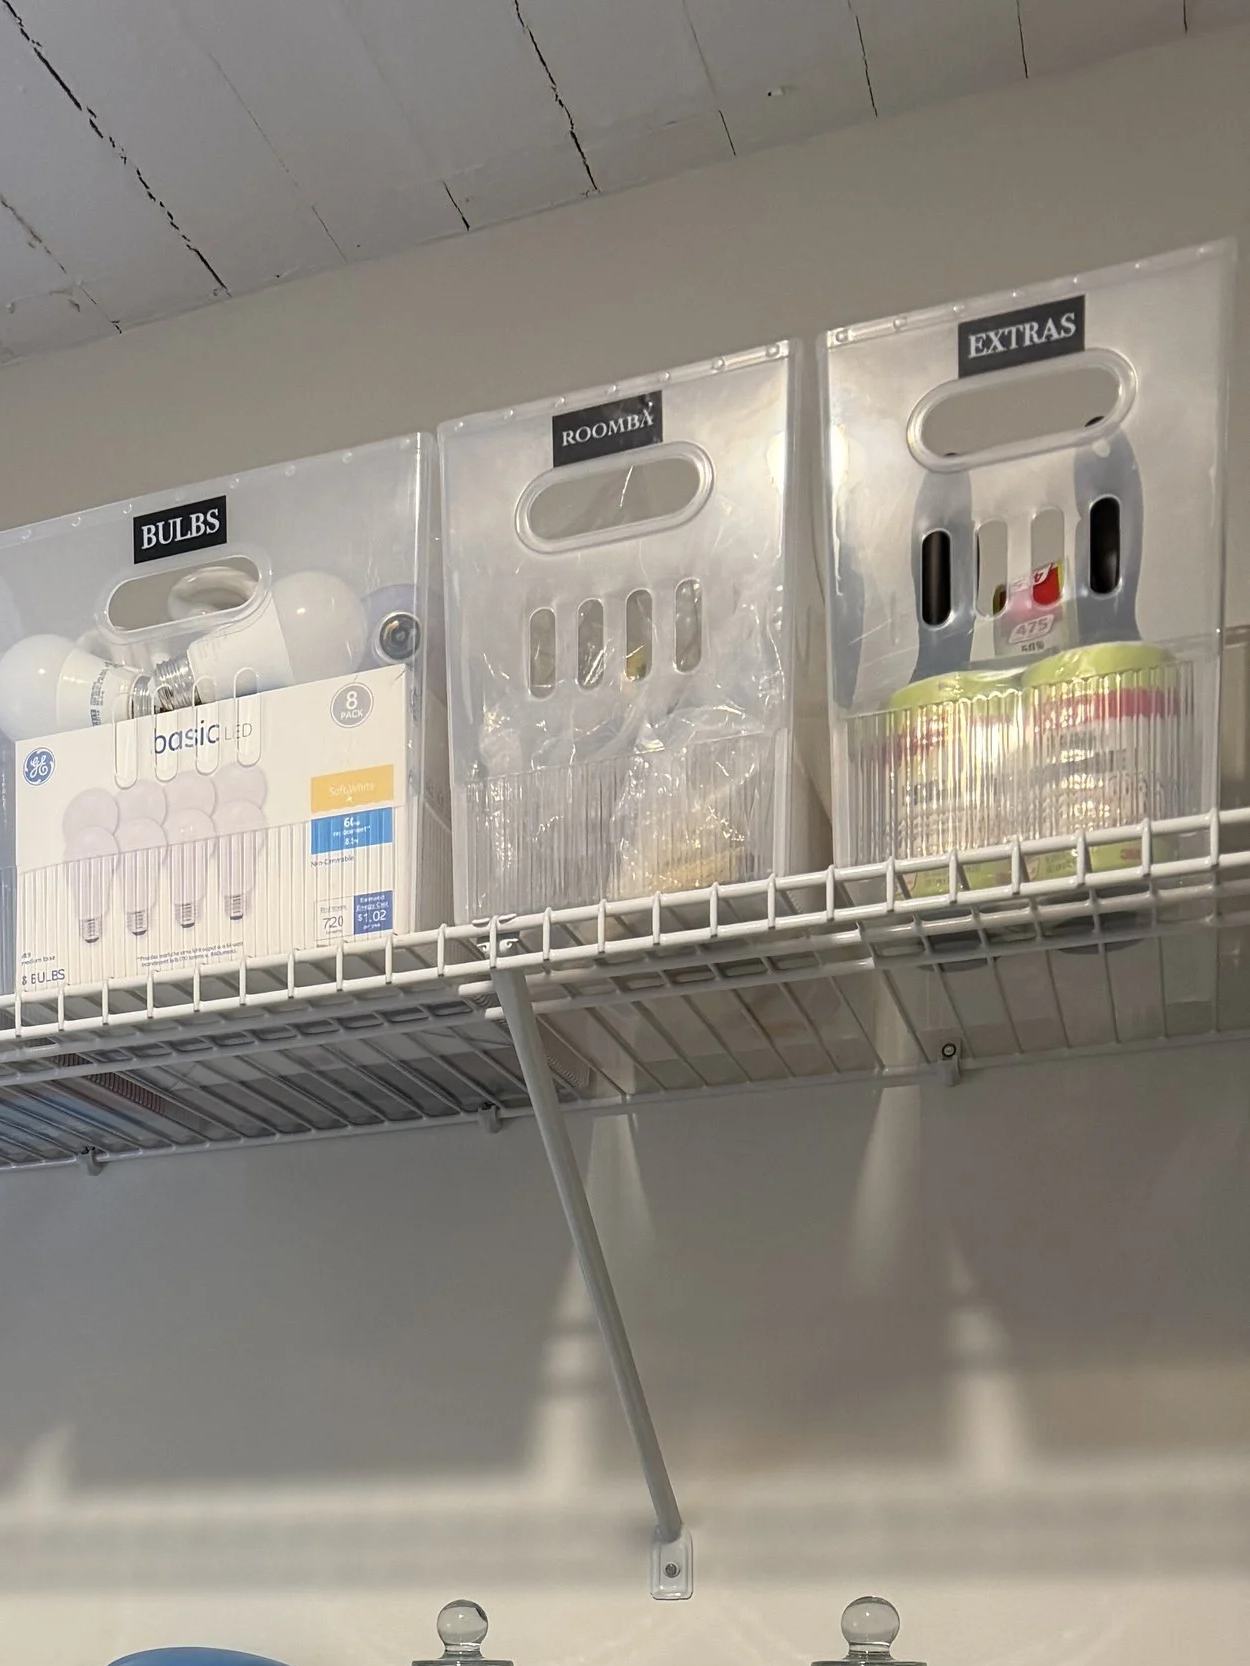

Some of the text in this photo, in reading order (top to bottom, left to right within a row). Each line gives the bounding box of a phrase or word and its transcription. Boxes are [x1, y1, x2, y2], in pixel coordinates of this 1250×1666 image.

[968, 312, 1077, 359] EXTRAS
[561, 408, 654, 447] ROOMBA
[141, 508, 220, 549] BULBS
[345, 690, 358, 710] 8
[340, 709, 364, 720] PACK
[153, 719, 220, 755] basic
[349, 781, 375, 794] White
[323, 910, 387, 929] 720 $1.02
